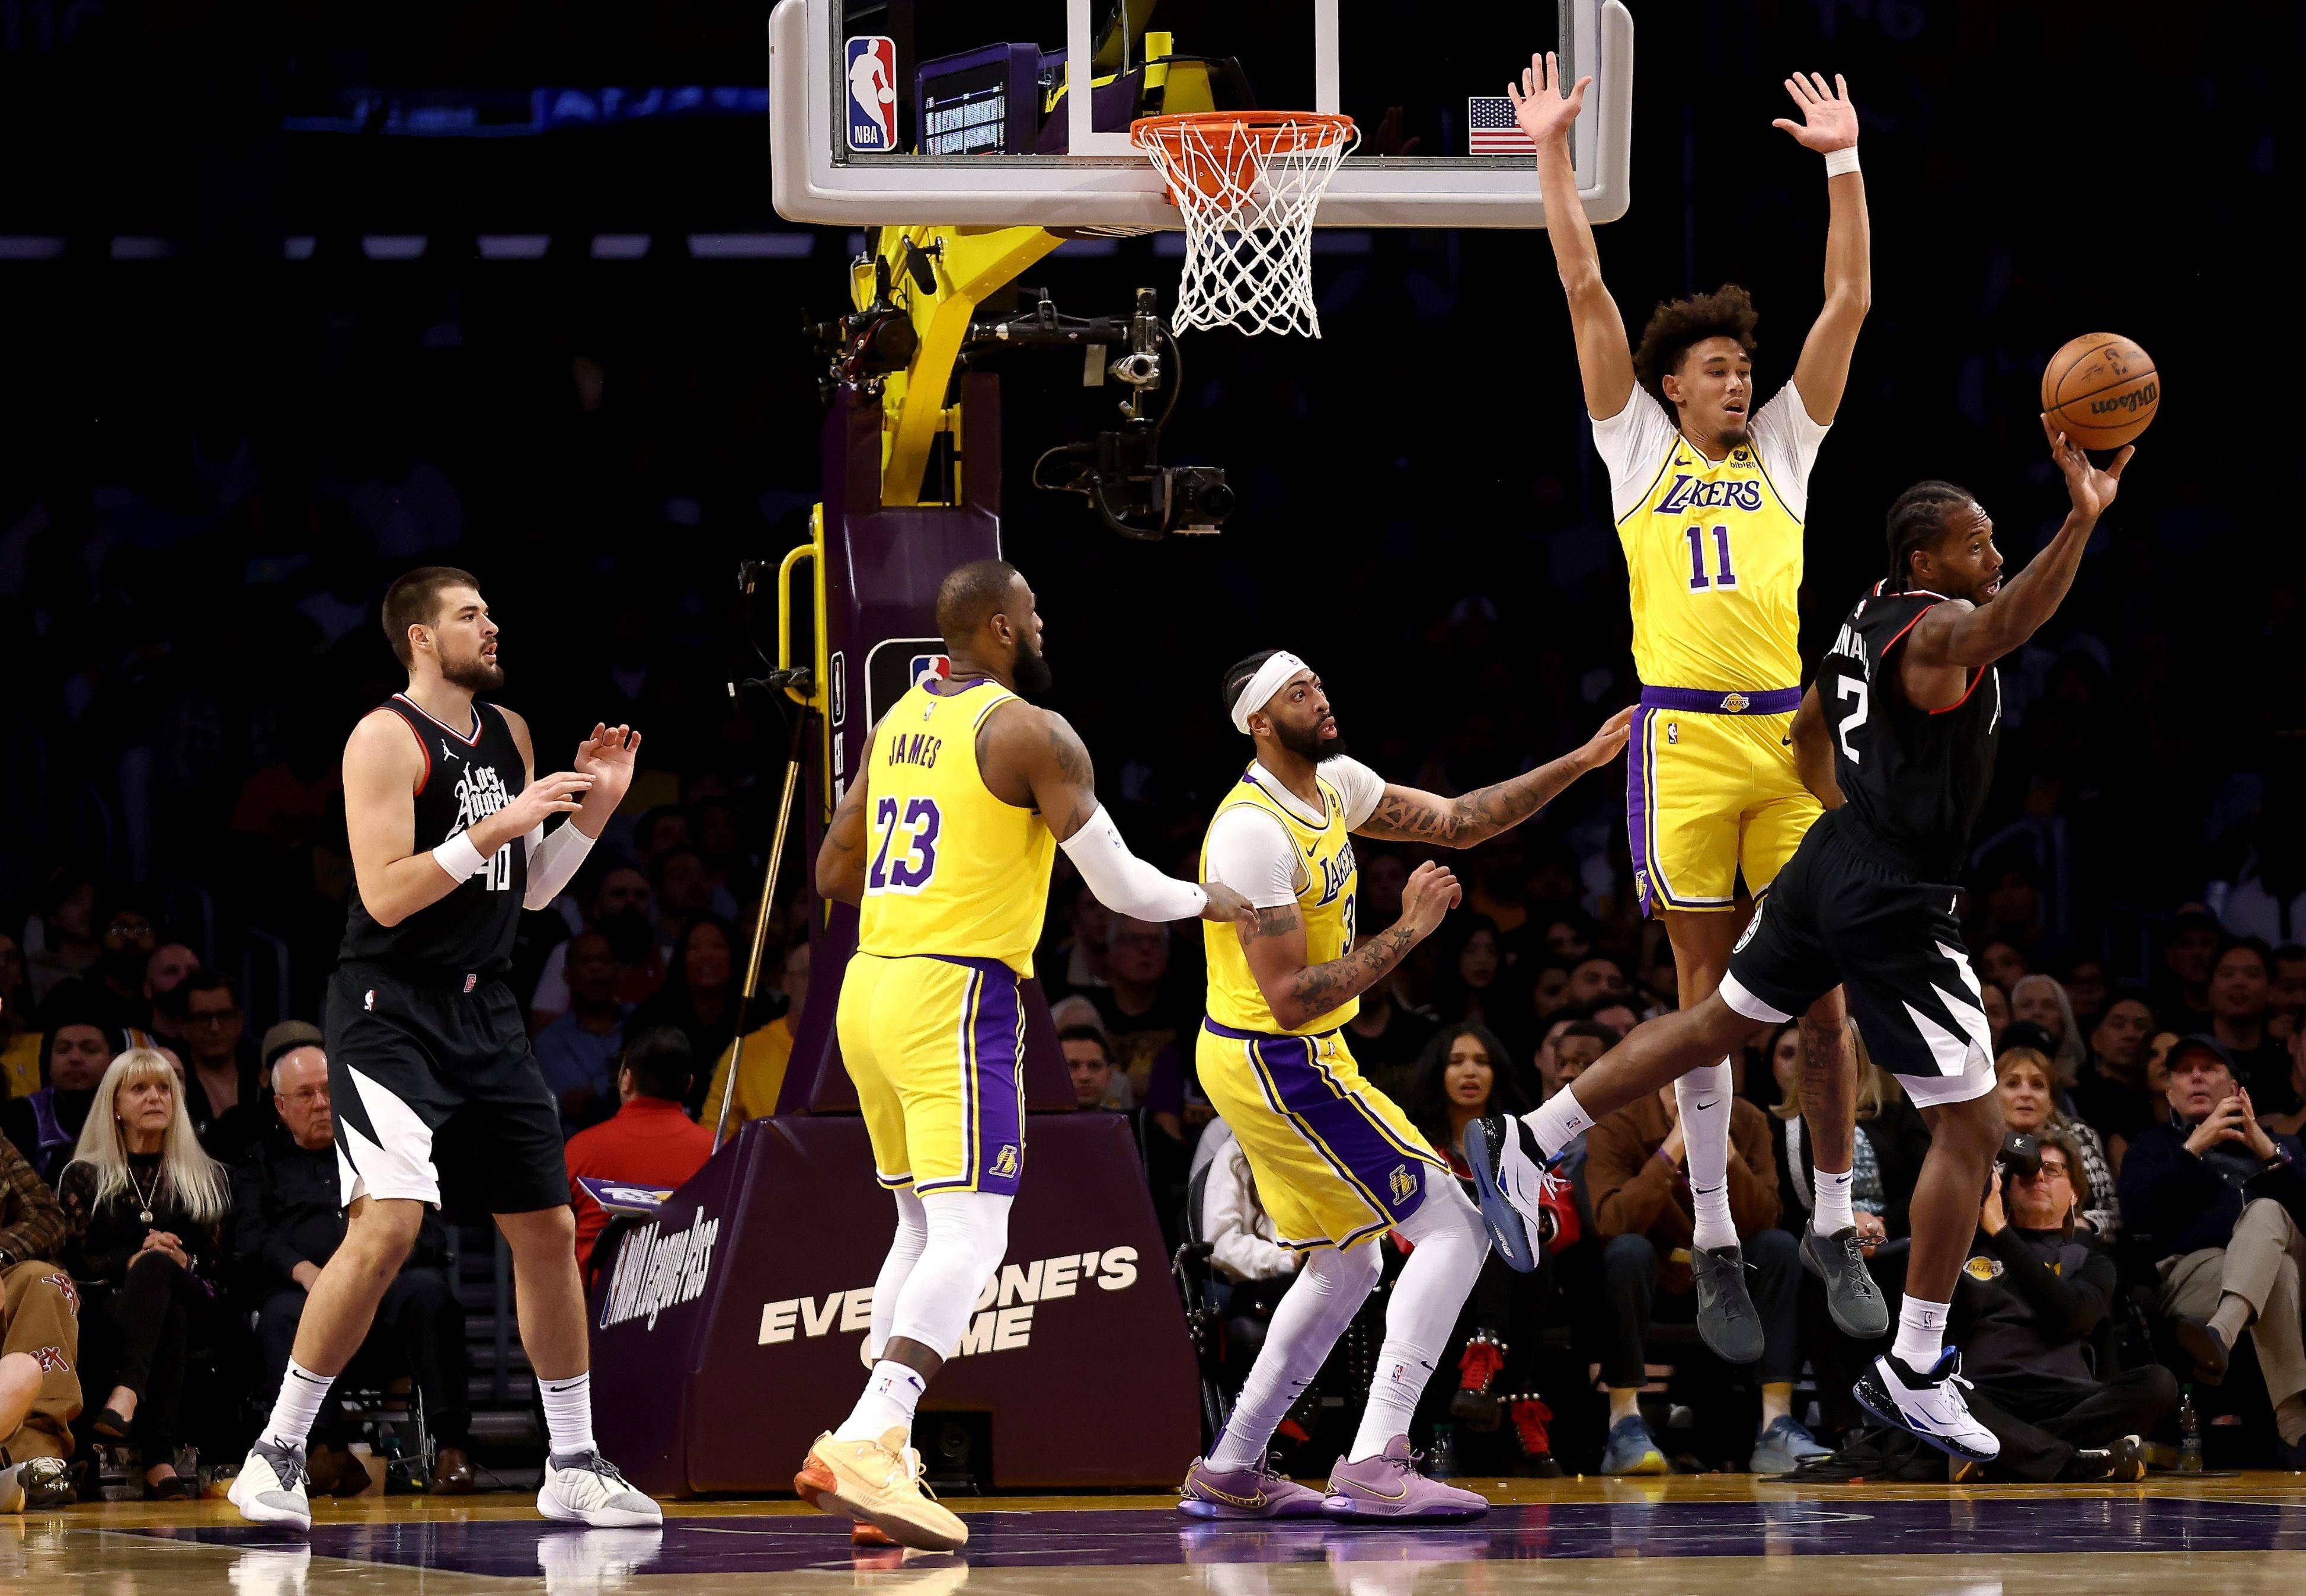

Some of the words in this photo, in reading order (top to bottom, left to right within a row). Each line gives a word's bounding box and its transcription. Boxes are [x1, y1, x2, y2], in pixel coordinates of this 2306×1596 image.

[854, 125, 878, 143] NBA
[2091, 382, 2157, 414] Wilson
[1653, 474, 1762, 514] LAKERS
[1730, 460, 1755, 469] bibigo
[1686, 525, 1736, 591] 11
[889, 733, 942, 769] JAMES
[1837, 674, 1868, 765] 2
[463, 761, 500, 794] Los
[445, 779, 516, 842] Angel
[868, 797, 941, 890] 23
[1315, 842, 1356, 907] LAKER
[1342, 893, 1354, 958] 3
[609, 1223, 654, 1326] NBA
[633, 1220, 691, 1332] League
[673, 1205, 719, 1306] Pass
[758, 1246, 1138, 1345] EVENE'S
